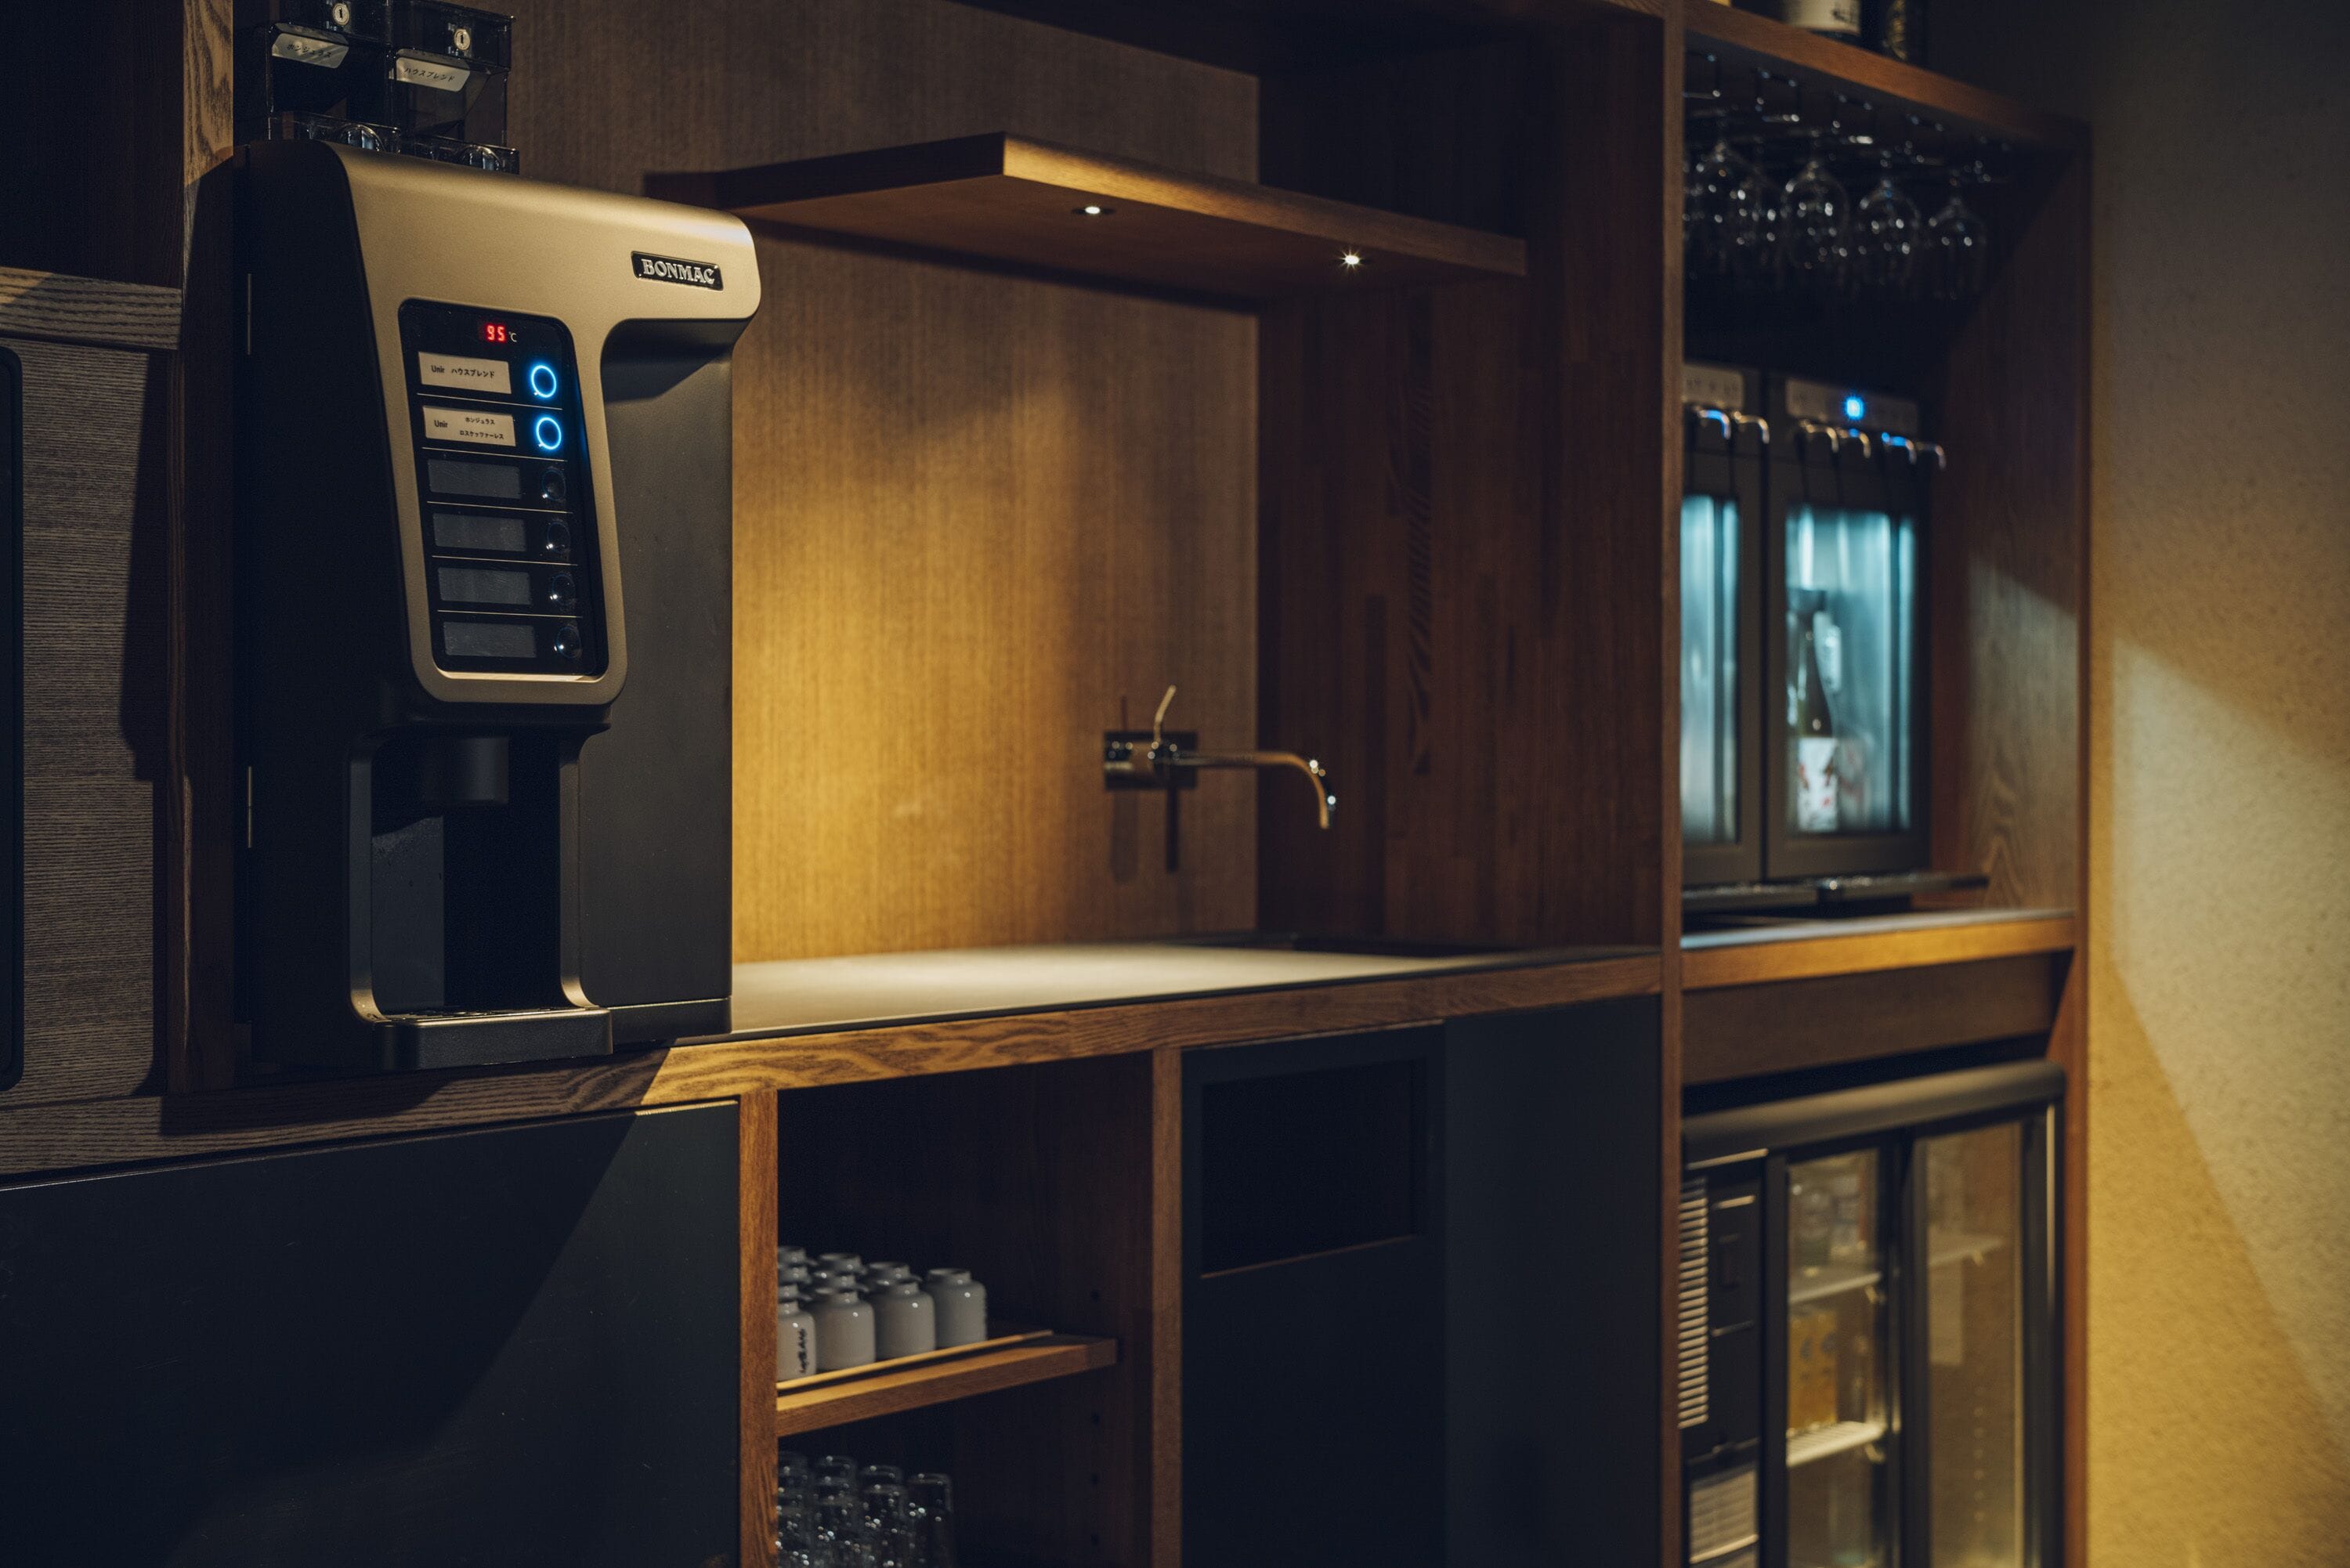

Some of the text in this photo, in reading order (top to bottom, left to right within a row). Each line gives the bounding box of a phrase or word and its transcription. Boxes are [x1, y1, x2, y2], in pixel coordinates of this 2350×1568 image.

[404, 67, 455, 82] ハウスブレンド
[641, 258, 715, 284] BONMAC
[486, 324, 506, 342] 95
[451, 368, 495, 379] ハウスブレンド
[465, 417, 495, 425] ホンジュラス
